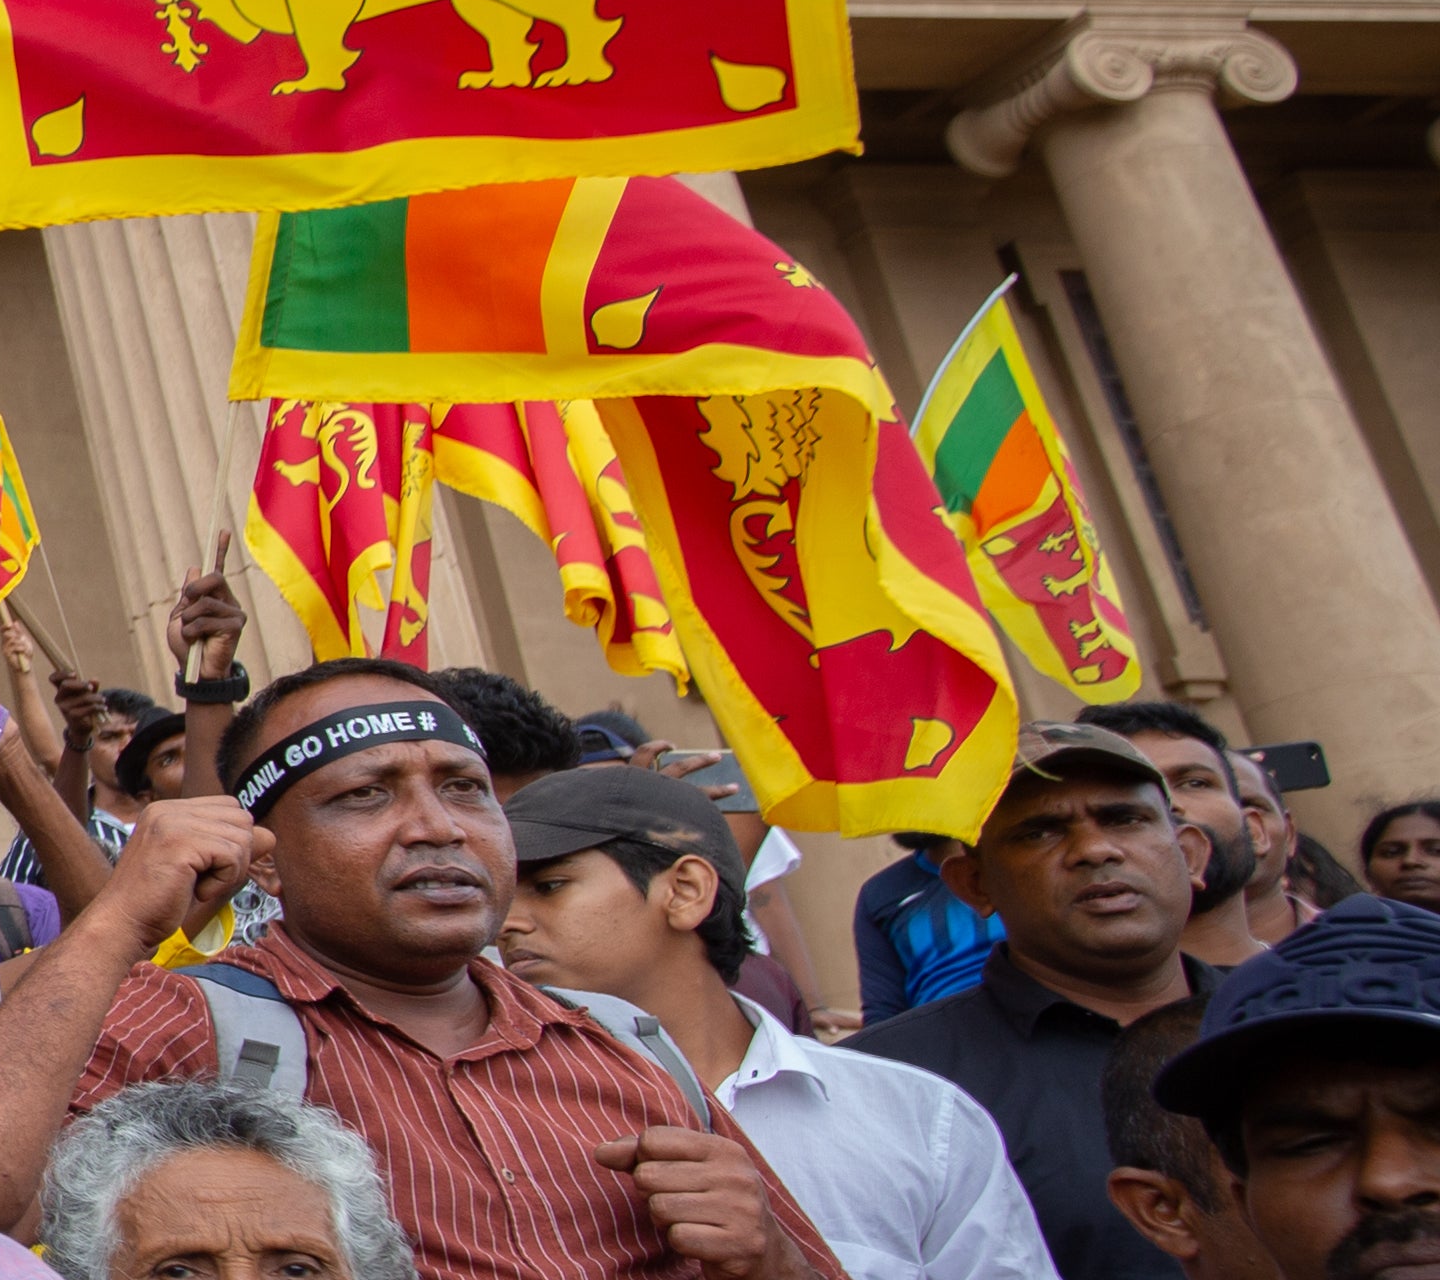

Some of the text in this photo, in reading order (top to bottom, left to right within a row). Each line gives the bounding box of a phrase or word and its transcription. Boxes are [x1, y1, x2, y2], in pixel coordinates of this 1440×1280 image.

[237, 759, 286, 812] RANIL
[284, 735, 323, 768] GO
[325, 711, 417, 749] HOME
